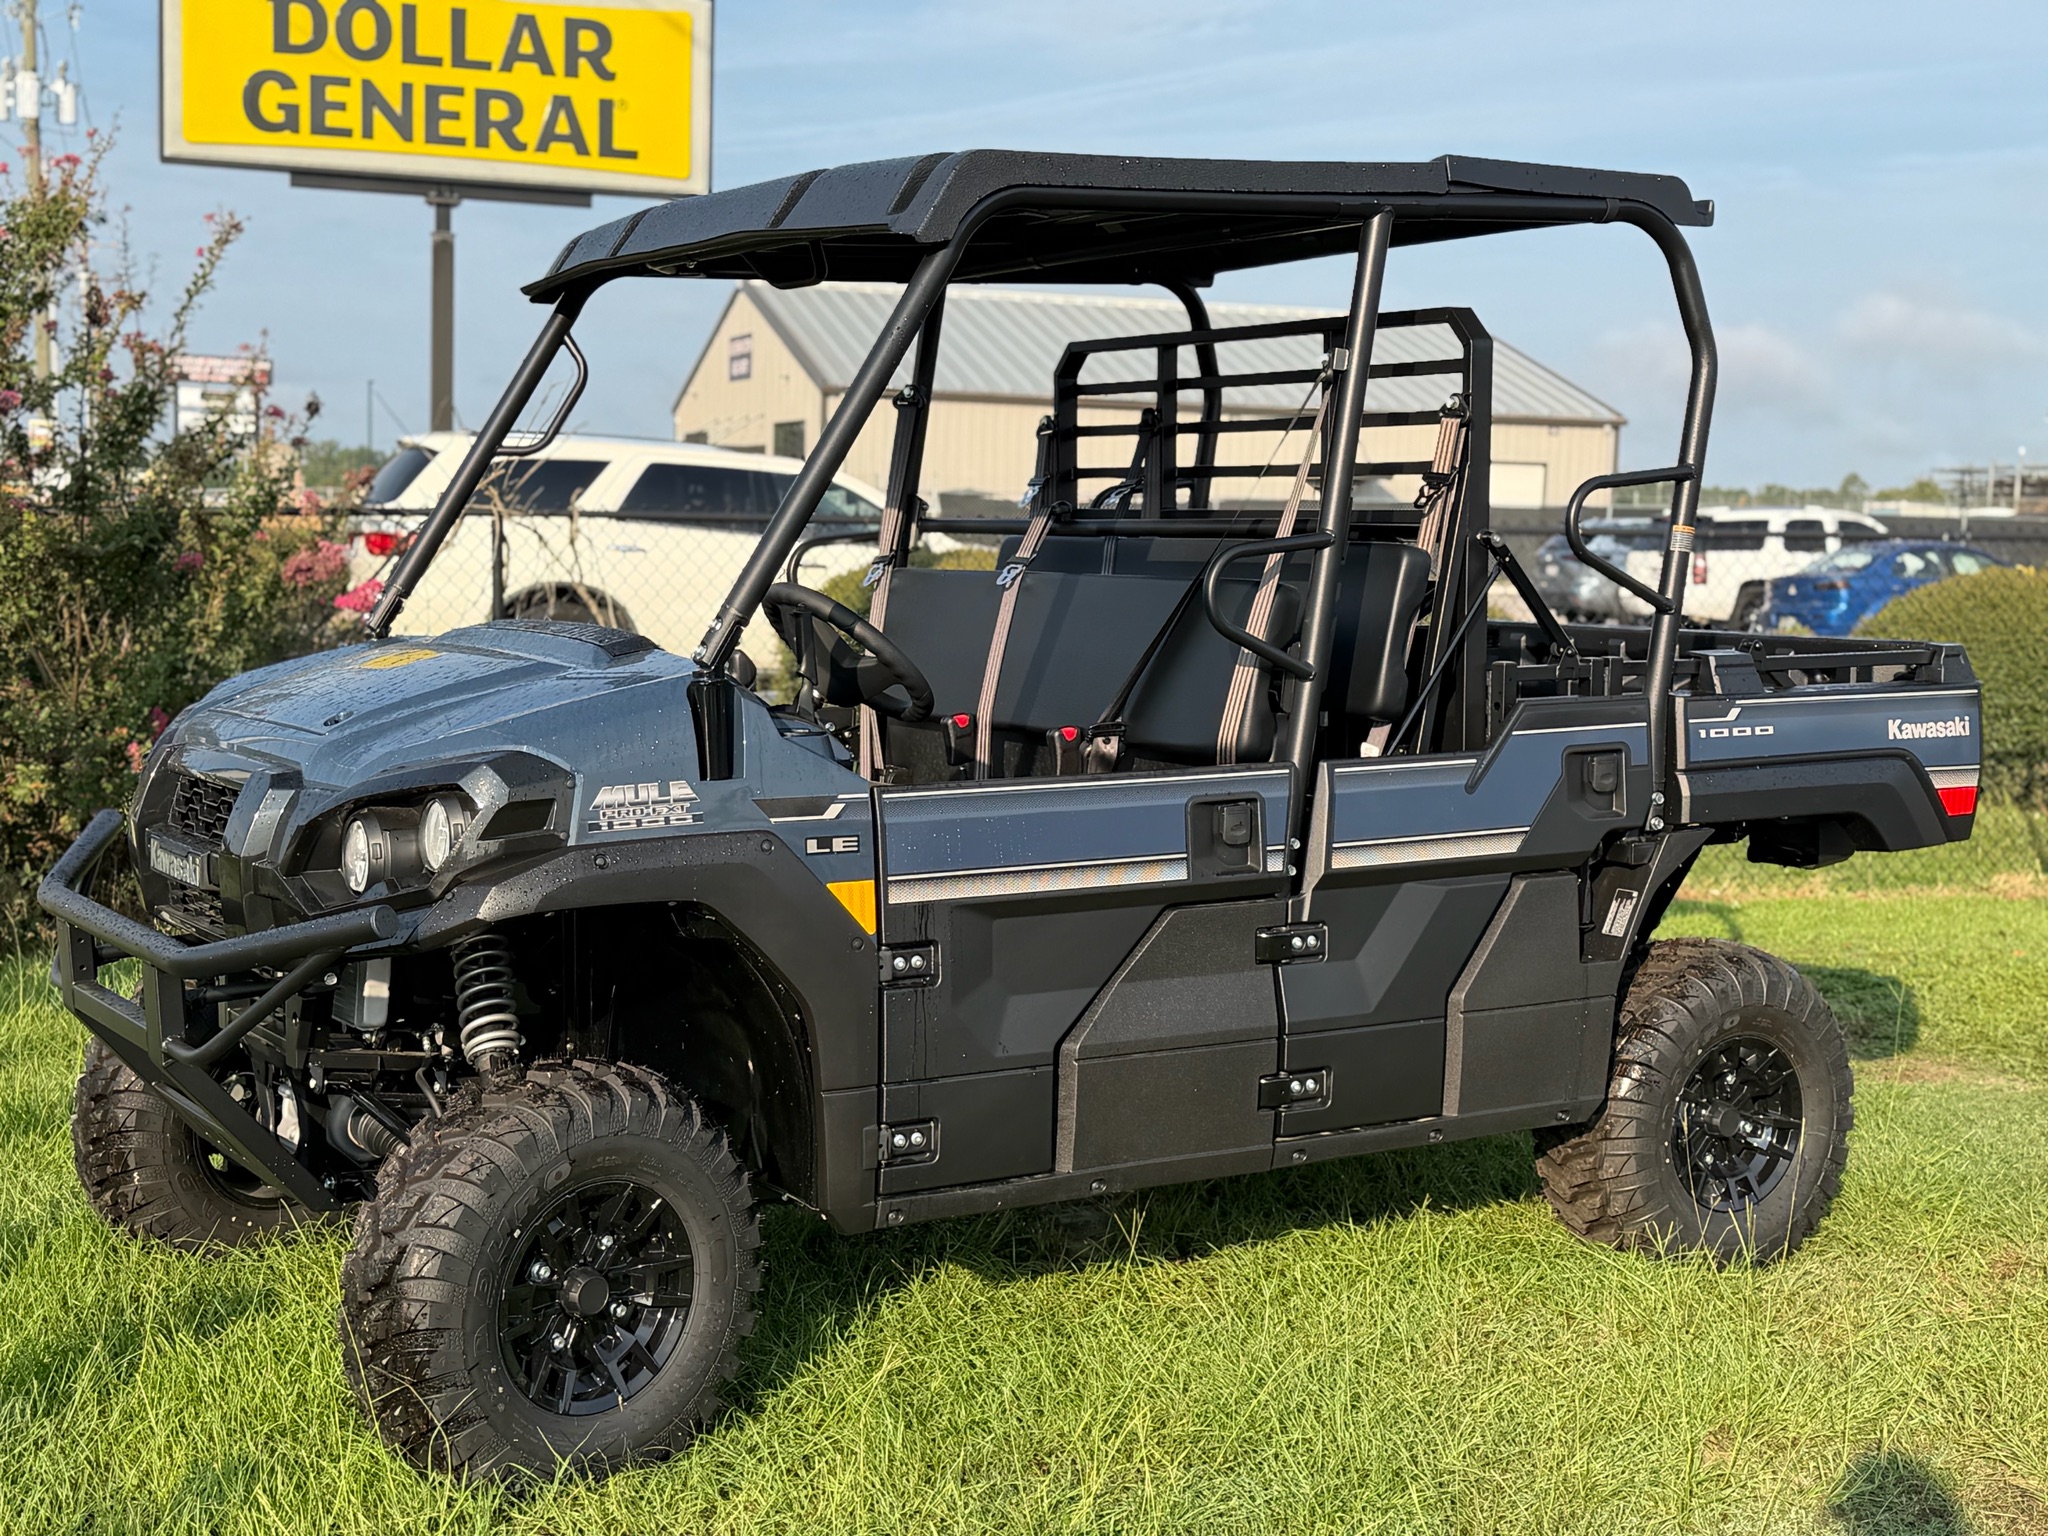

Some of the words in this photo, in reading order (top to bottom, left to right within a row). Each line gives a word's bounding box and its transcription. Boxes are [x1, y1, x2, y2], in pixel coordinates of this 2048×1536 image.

[266, 0, 617, 81] DOLLAR
[242, 69, 638, 160] GENERAL
[1698, 725, 1774, 738] 1000
[1888, 716, 1970, 740] Kawasaki
[589, 780, 701, 811] MULE
[806, 836, 859, 853] LE
[150, 837, 200, 888] Kawasaki
